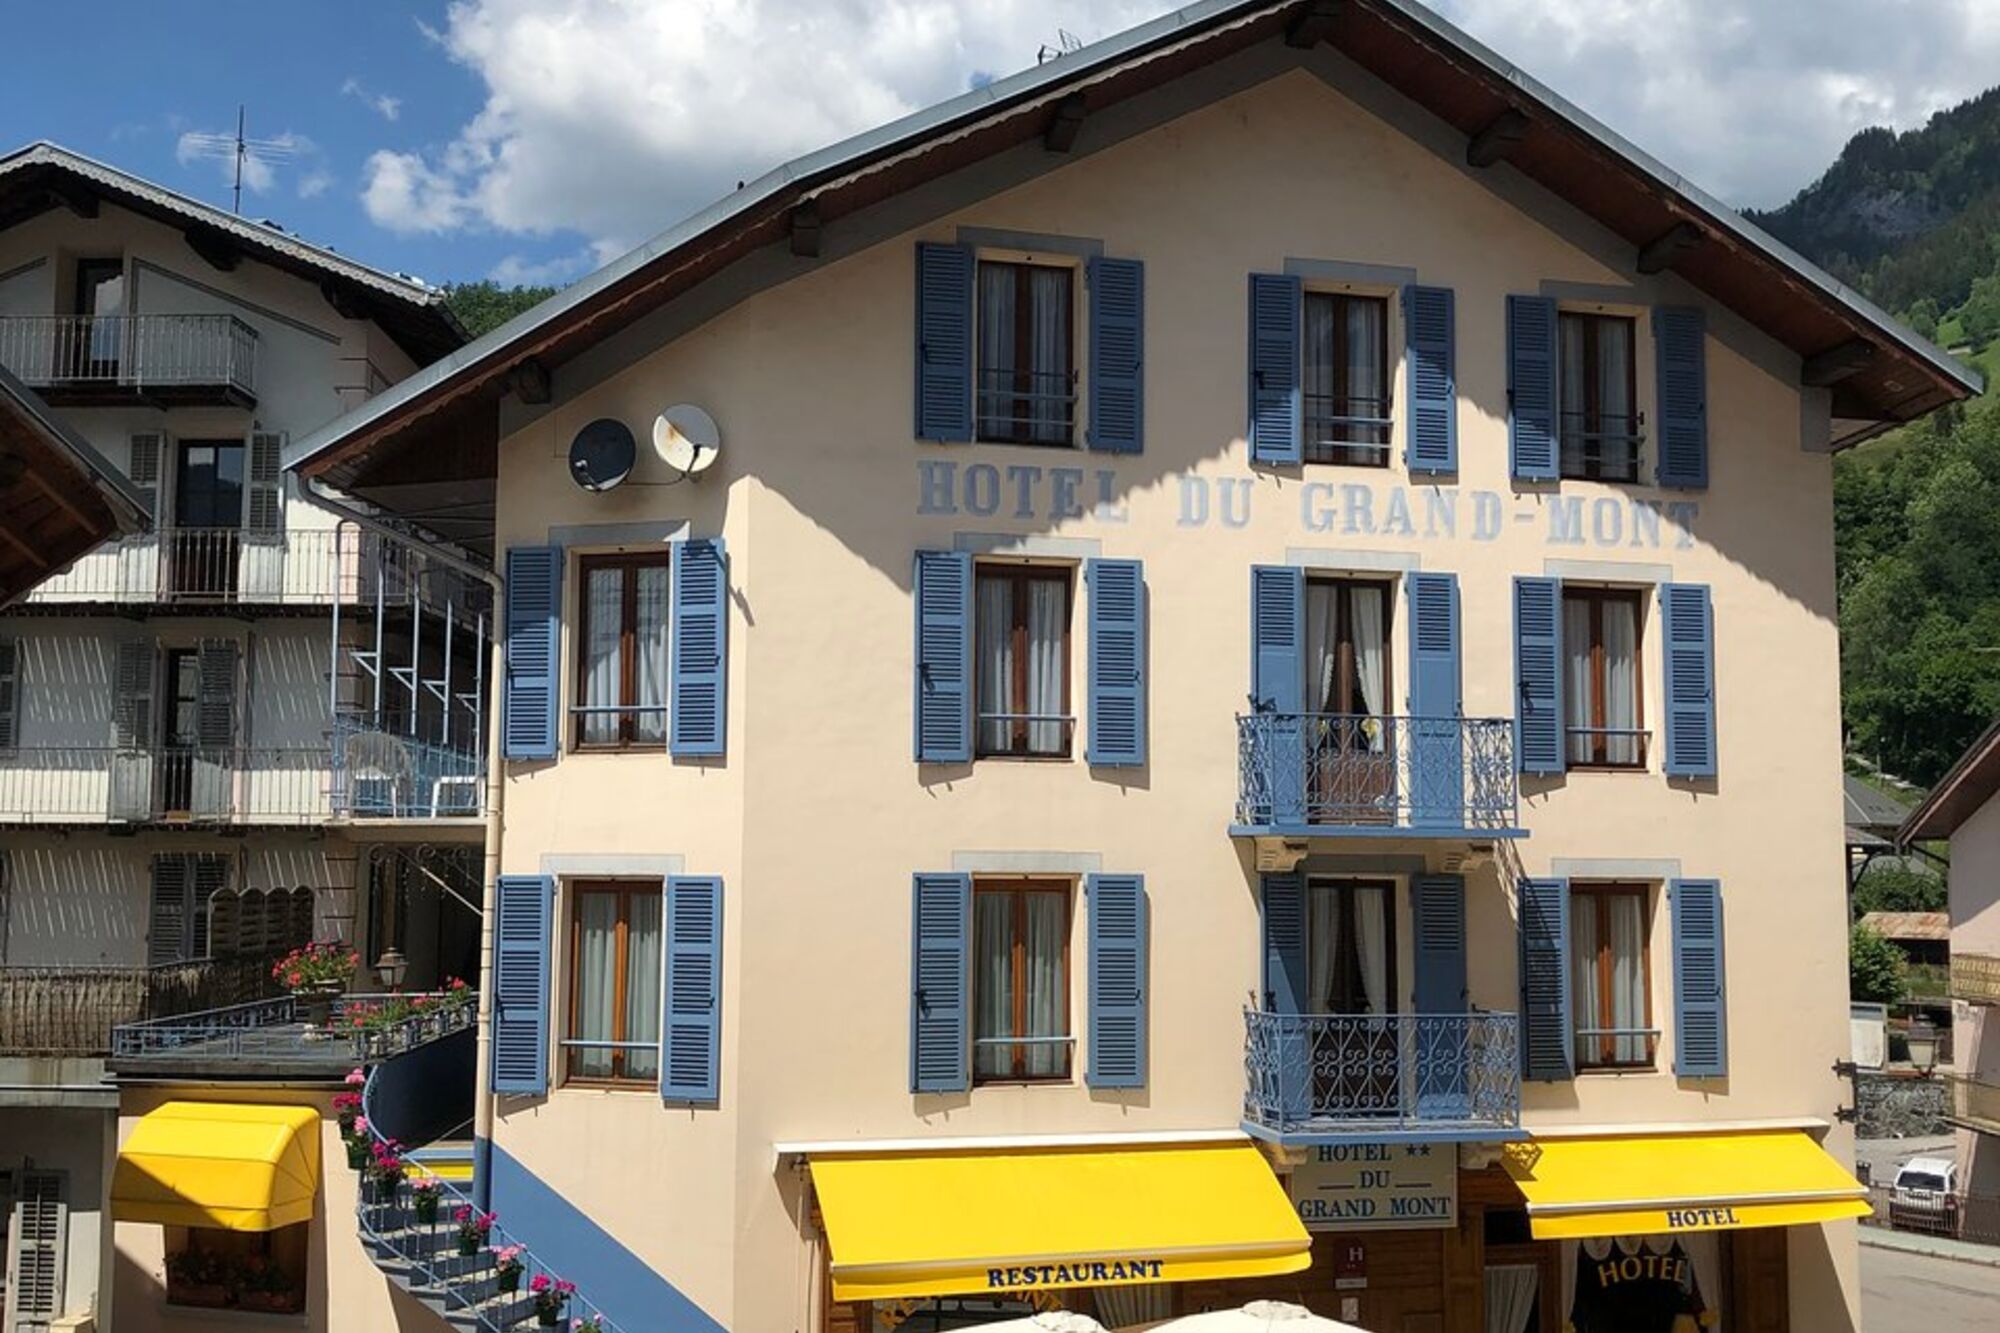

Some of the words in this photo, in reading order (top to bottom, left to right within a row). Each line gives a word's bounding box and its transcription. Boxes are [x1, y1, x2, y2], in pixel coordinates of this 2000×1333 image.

[916, 460, 1129, 523] HOTEL
[1177, 474, 1254, 528] DU
[1300, 482, 1699, 550] GRAND-MONT
[1318, 1143, 1392, 1162] HOTEL
[1360, 1170, 1390, 1189] DU
[1298, 1199, 1376, 1217] GRAND
[1389, 1197, 1451, 1215] MONT
[1666, 1207, 1740, 1228] HOTEL
[1349, 1247, 1363, 1262] H
[987, 1260, 1164, 1287] RESTAURANT
[1598, 1255, 1688, 1288] HOTEL
